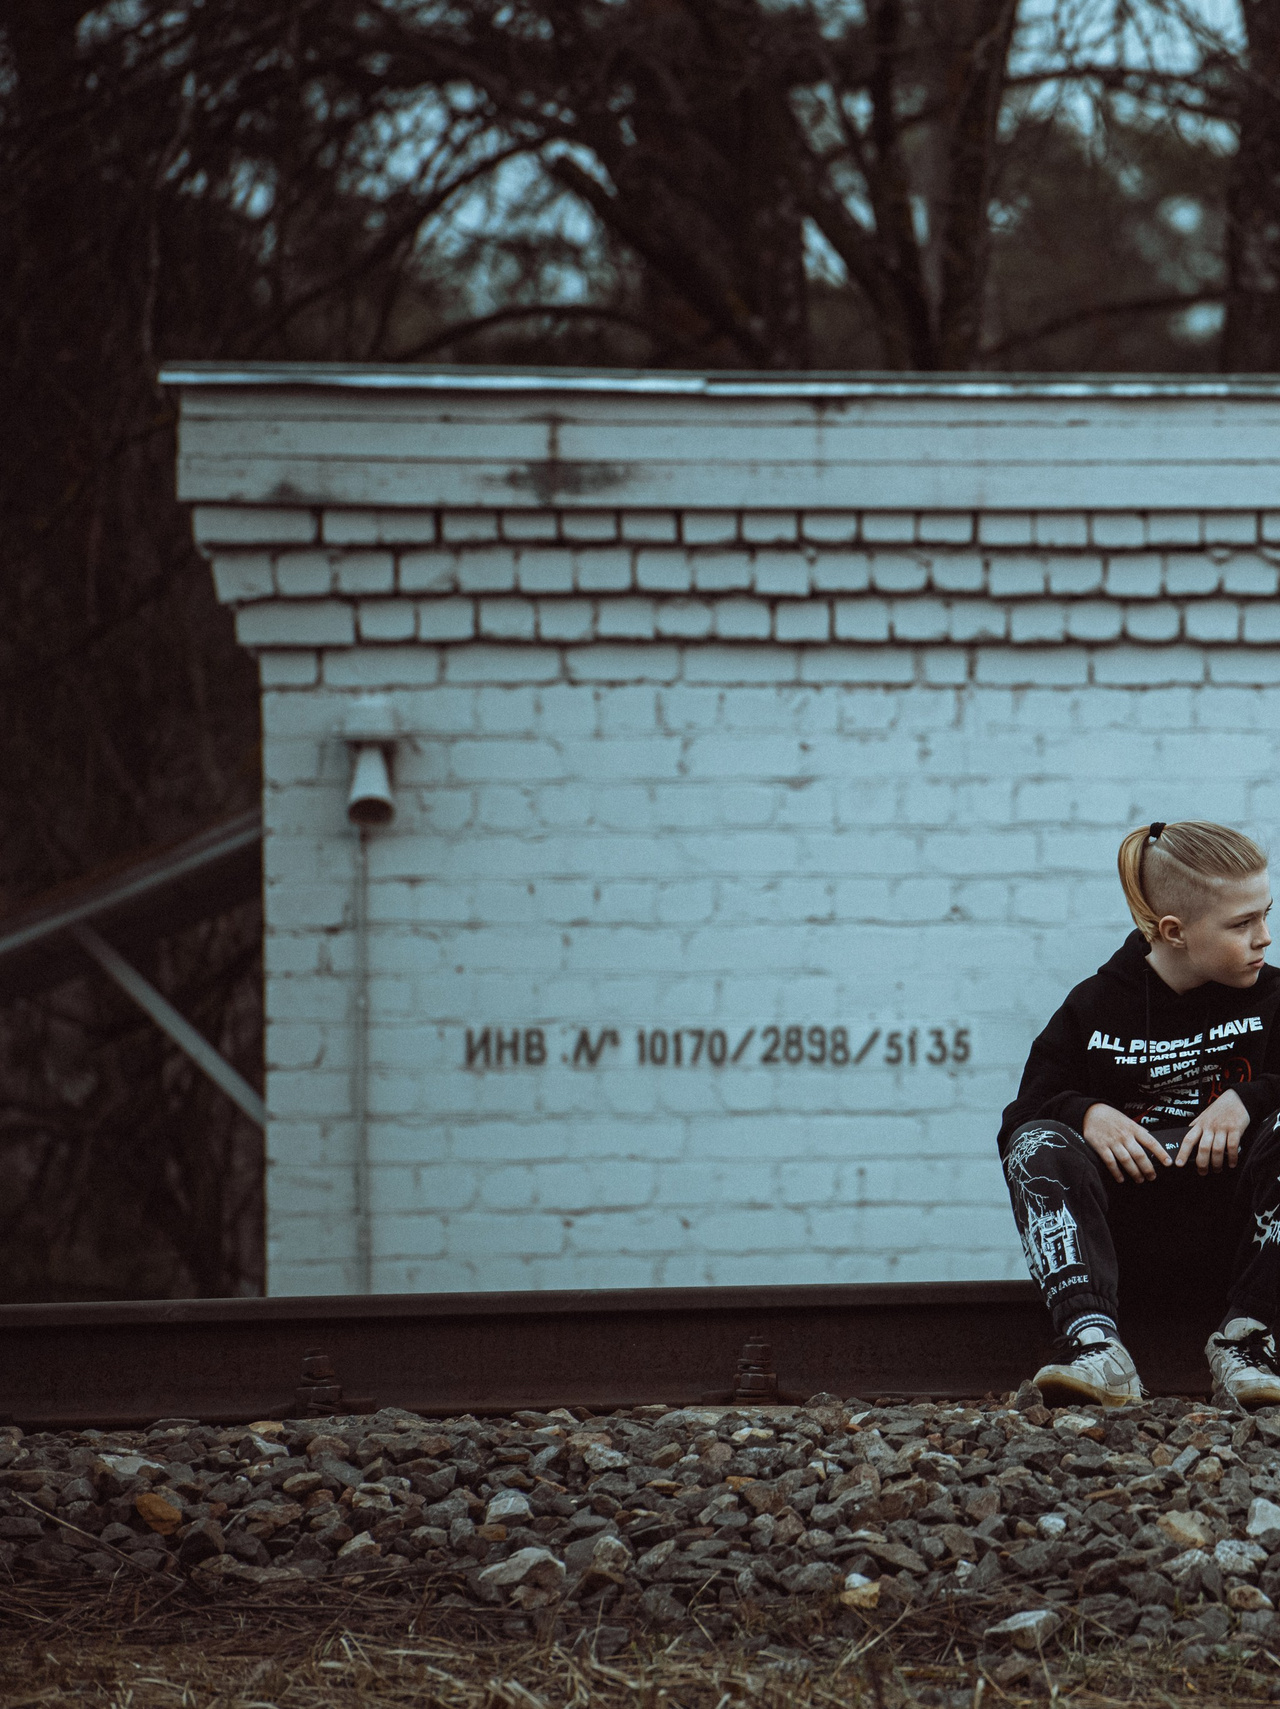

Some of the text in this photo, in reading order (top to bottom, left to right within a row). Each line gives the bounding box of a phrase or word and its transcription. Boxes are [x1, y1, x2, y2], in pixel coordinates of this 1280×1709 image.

[1087, 1016, 1264, 1054] ALL PEOPLE HAVE
[1114, 1041, 1235, 1065] THE STARS BUT THEY
[1172, 1058, 1198, 1072] NOT
